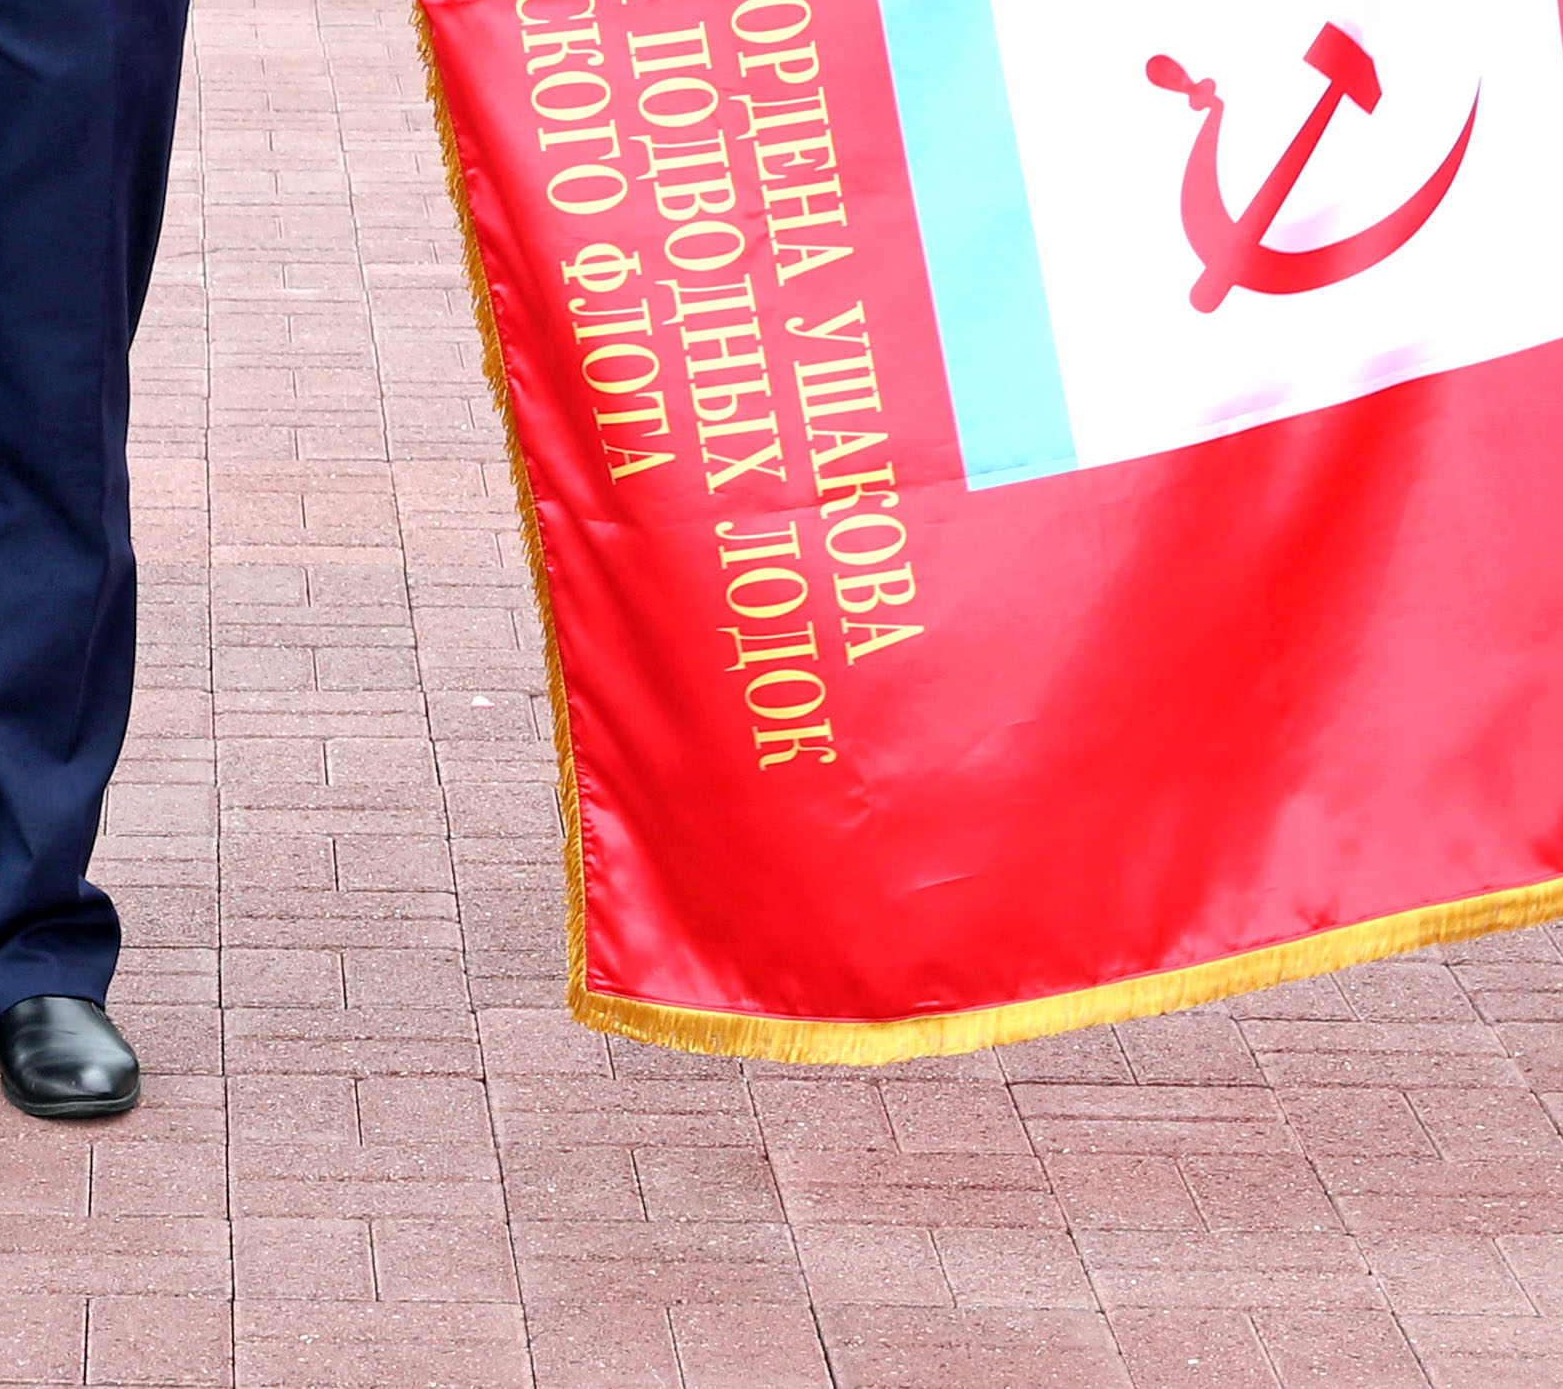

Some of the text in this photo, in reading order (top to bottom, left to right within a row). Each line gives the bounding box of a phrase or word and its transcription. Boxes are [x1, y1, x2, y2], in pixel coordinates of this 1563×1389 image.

[561, 243, 676, 485] ФЛОТА
[627, 21, 786, 494] ПОДВОДНЫХ
[715, 520, 837, 770] ЛОДОК
[784, 300, 924, 666] УШАКОВА
